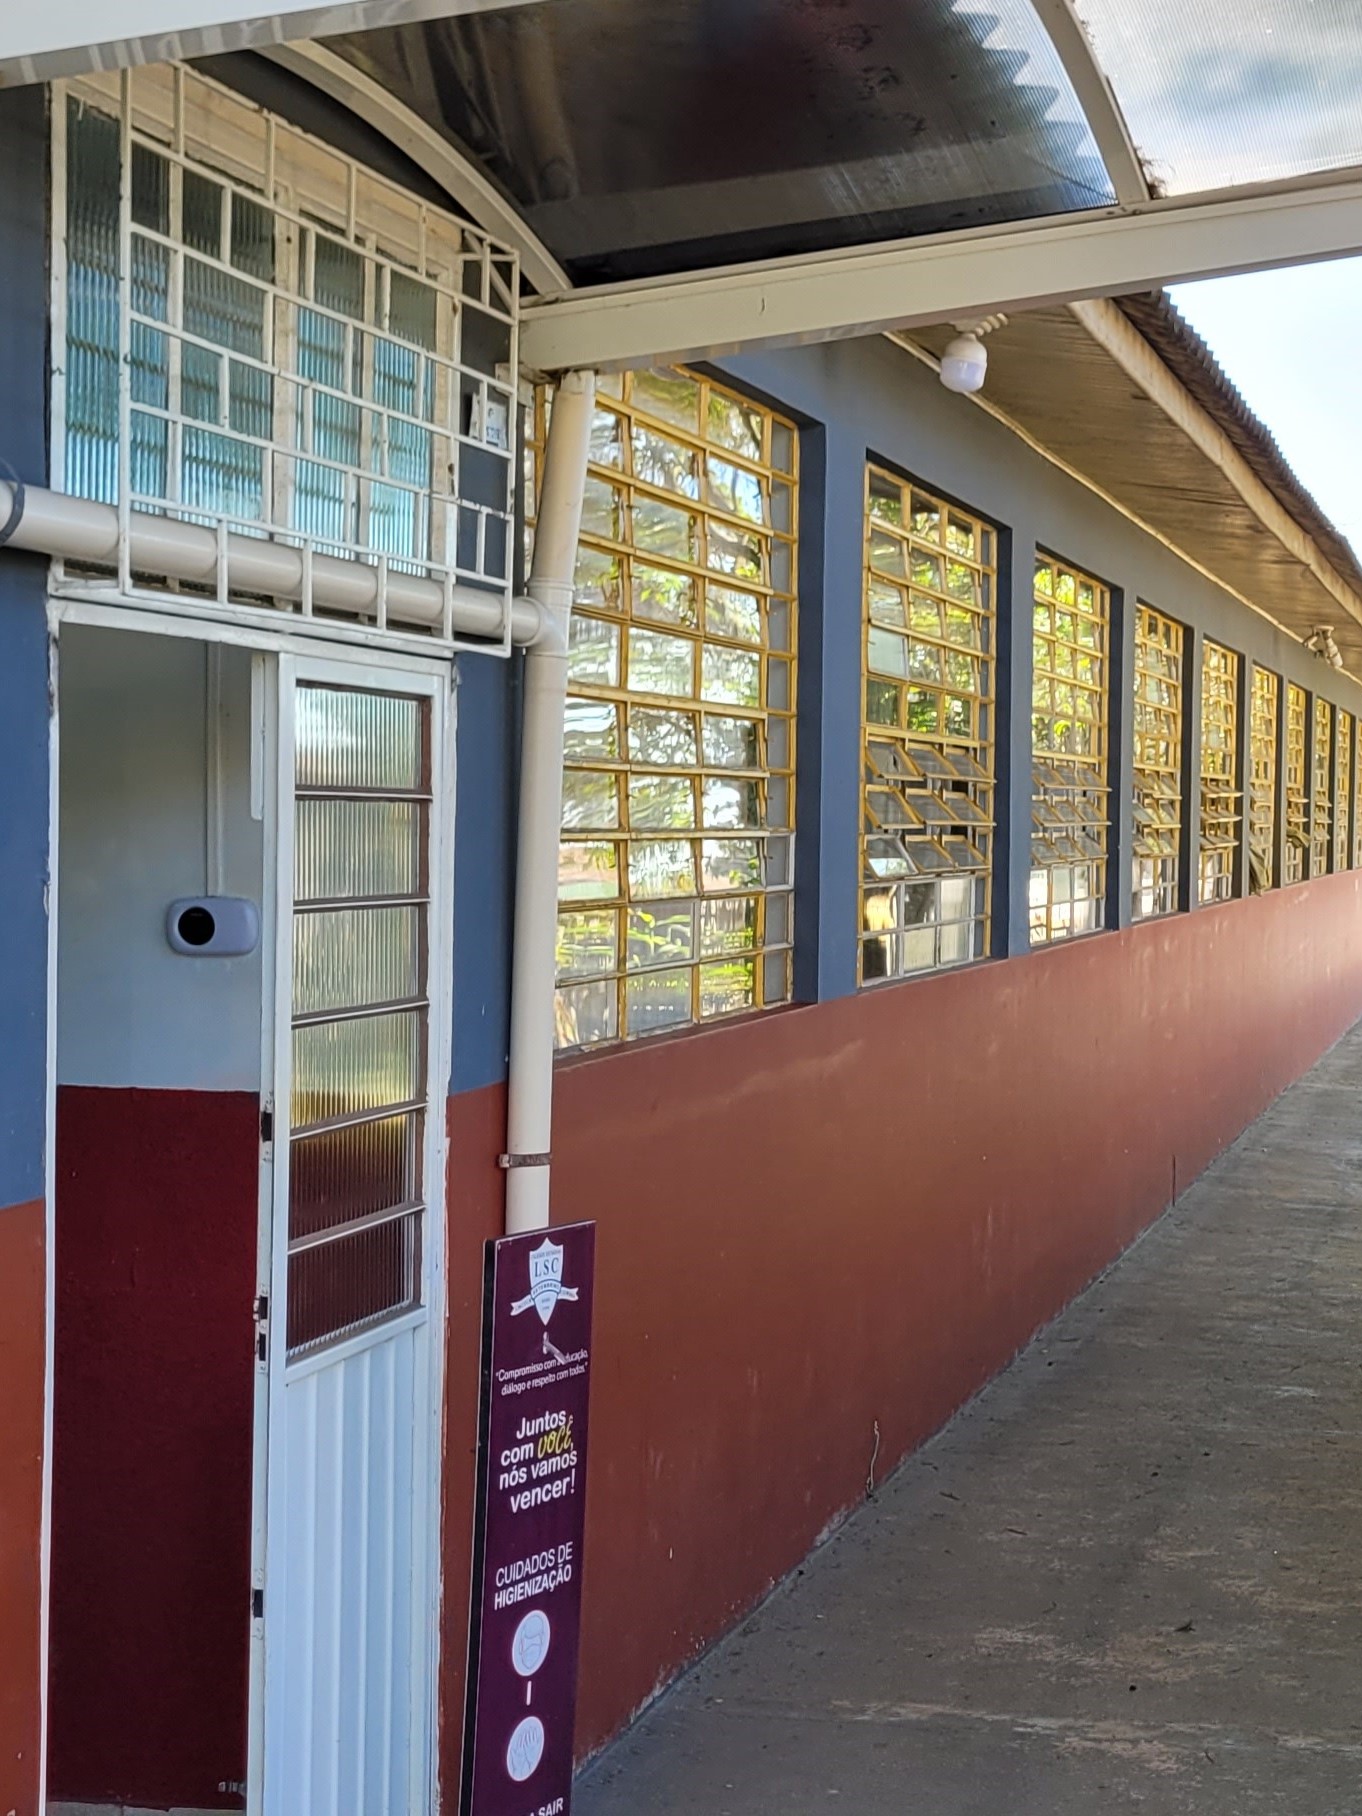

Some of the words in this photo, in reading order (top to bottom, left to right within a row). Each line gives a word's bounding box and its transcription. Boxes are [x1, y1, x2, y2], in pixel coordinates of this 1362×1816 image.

[533, 1257, 560, 1278] LSC
[543, 1359, 556, 1370] com
[501, 1381, 526, 1396] diálogo
[526, 1381, 532, 1389] e
[531, 1372, 556, 1388] respeito
[556, 1369, 569, 1381] com
[516, 1410, 567, 1440] Juntos
[500, 1442, 535, 1467] com
[499, 1464, 528, 1490] nós
[531, 1450, 578, 1480] vamos
[510, 1468, 576, 1514] vencer!
[495, 1548, 556, 1588] CUIDADOS
[557, 1541, 574, 1563] DE
[494, 1564, 573, 1611] HIGIENIZAÇÃO
[538, 1797, 564, 1816] SAIR
